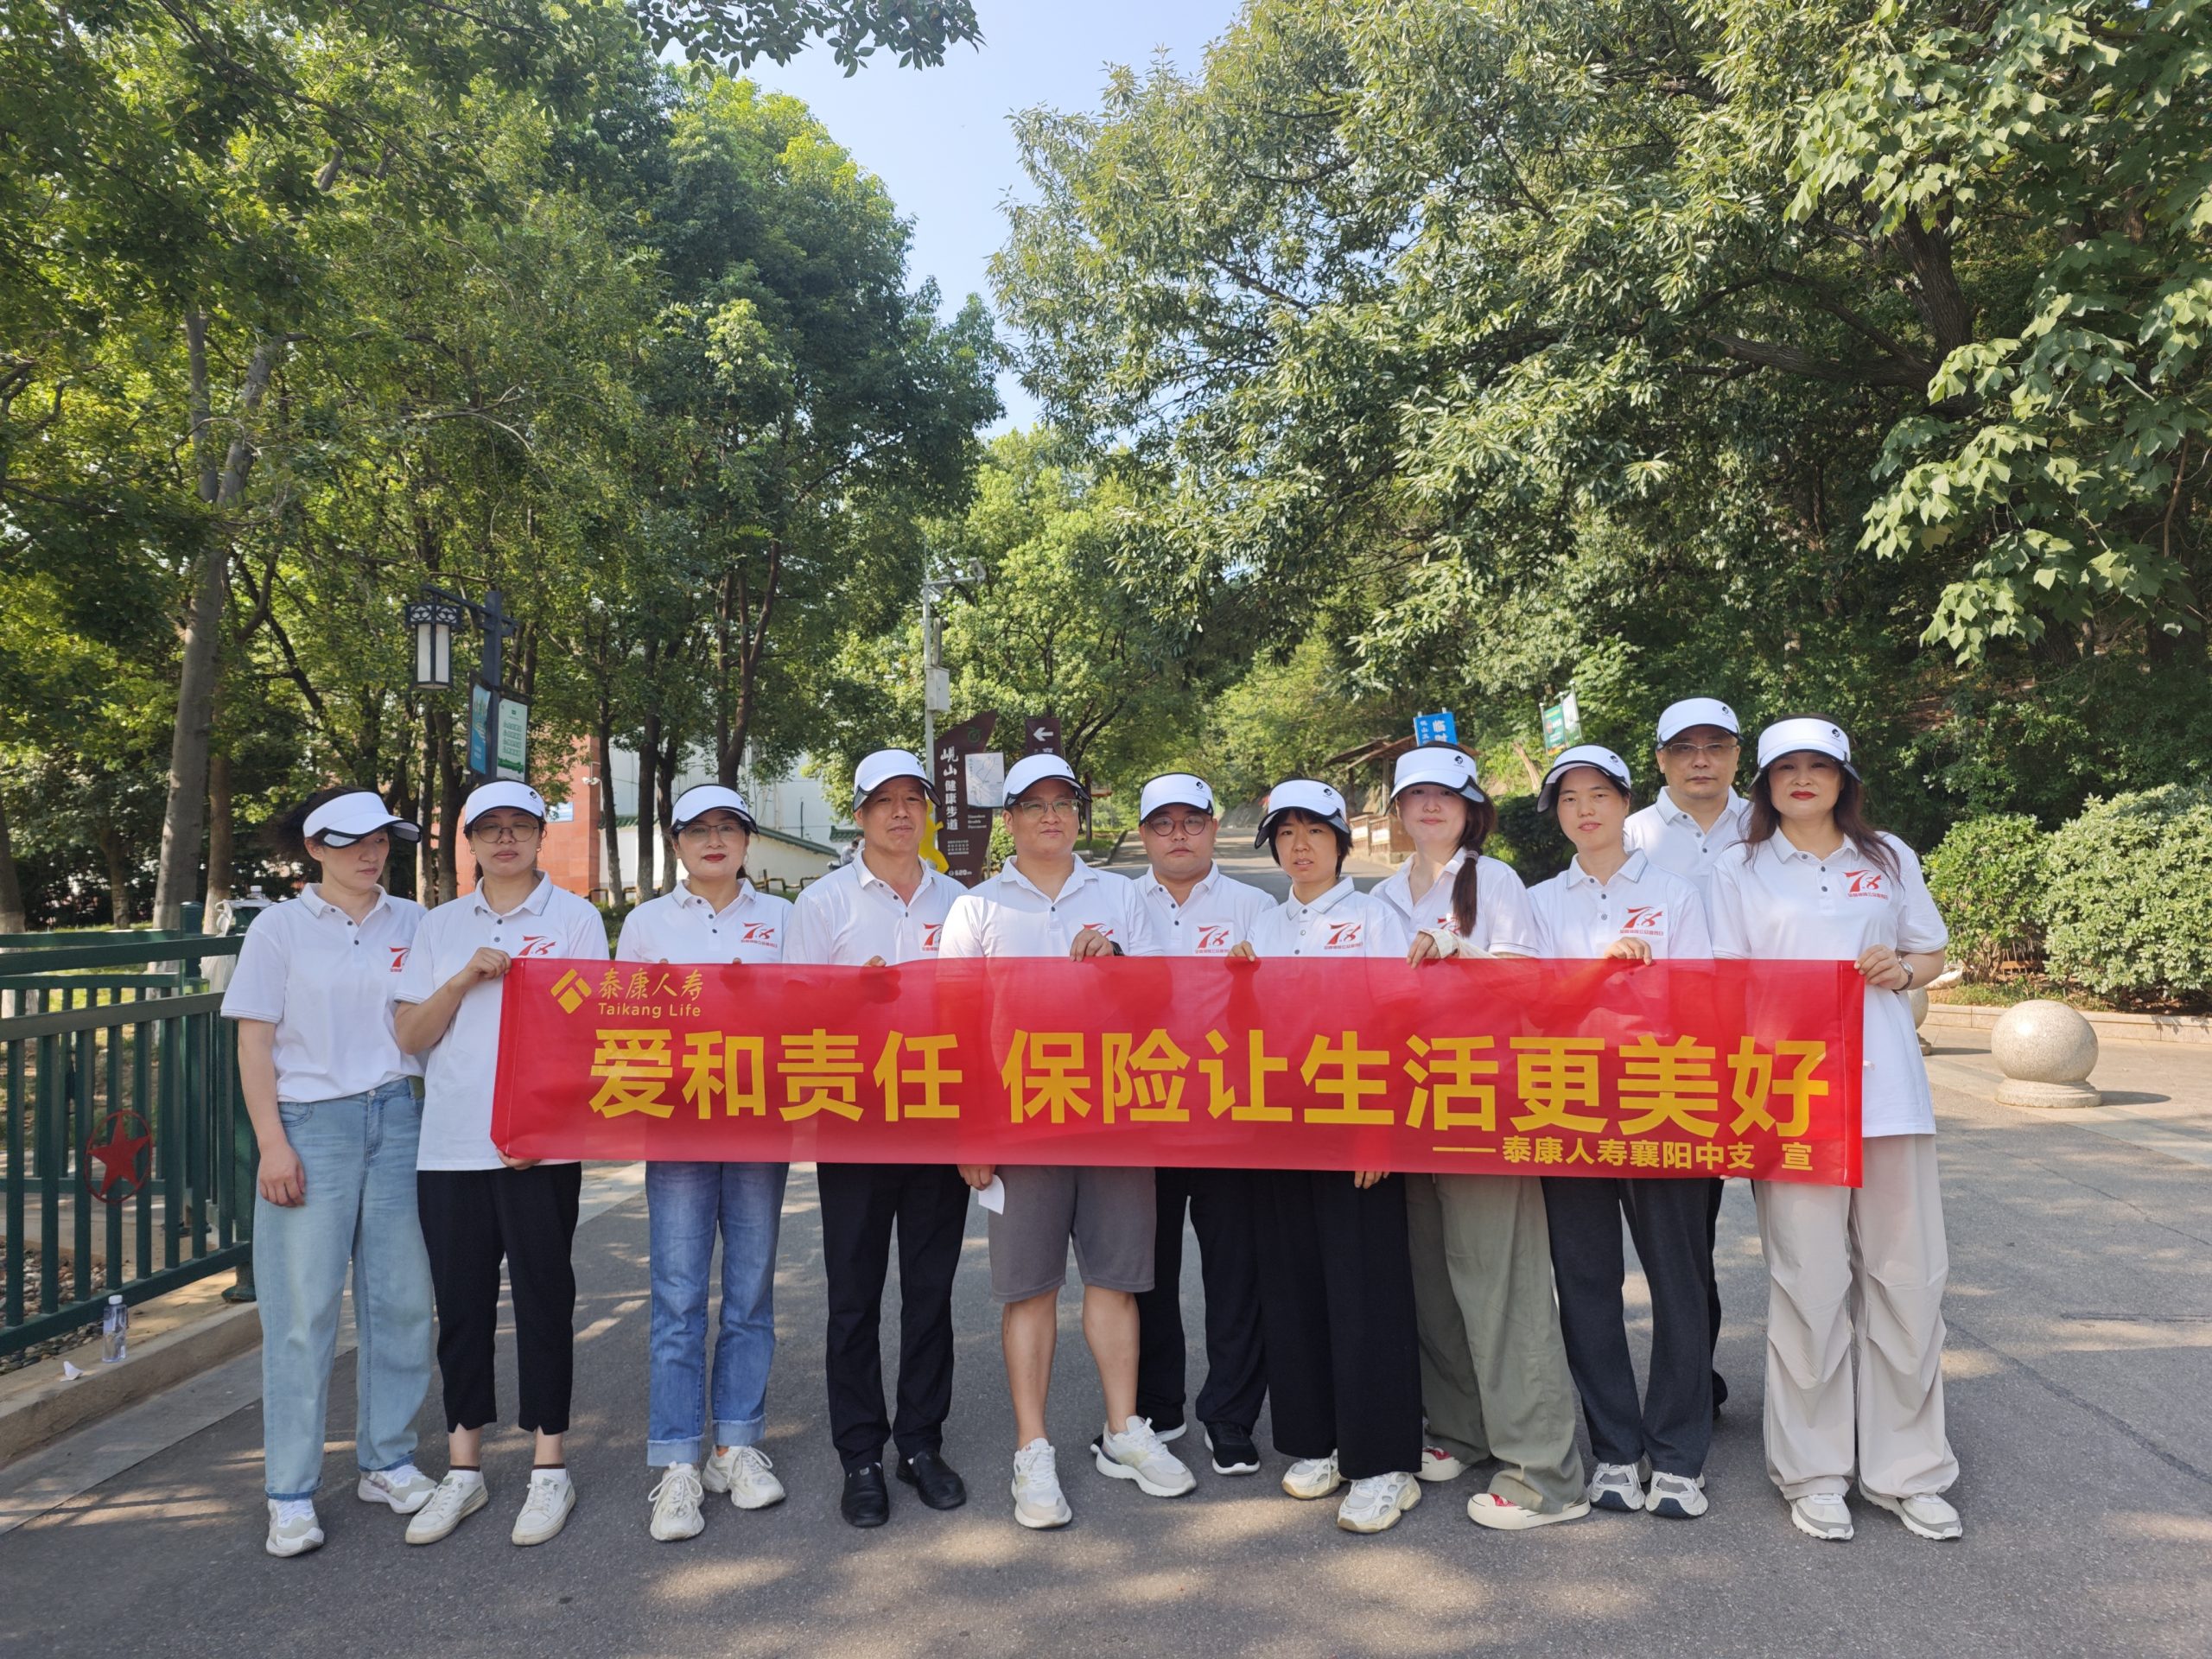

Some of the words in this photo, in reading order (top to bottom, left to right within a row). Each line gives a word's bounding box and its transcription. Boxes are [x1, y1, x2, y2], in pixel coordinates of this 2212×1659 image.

[597, 967, 704, 1001] 泰康人寿
[598, 1002, 662, 1019] Taikang
[669, 1003, 702, 1017] Life
[588, 1028, 963, 1122] 爱和责任
[1001, 1027, 1829, 1138] 保险让生活更美好
[1781, 1141, 1814, 1172] 宣
